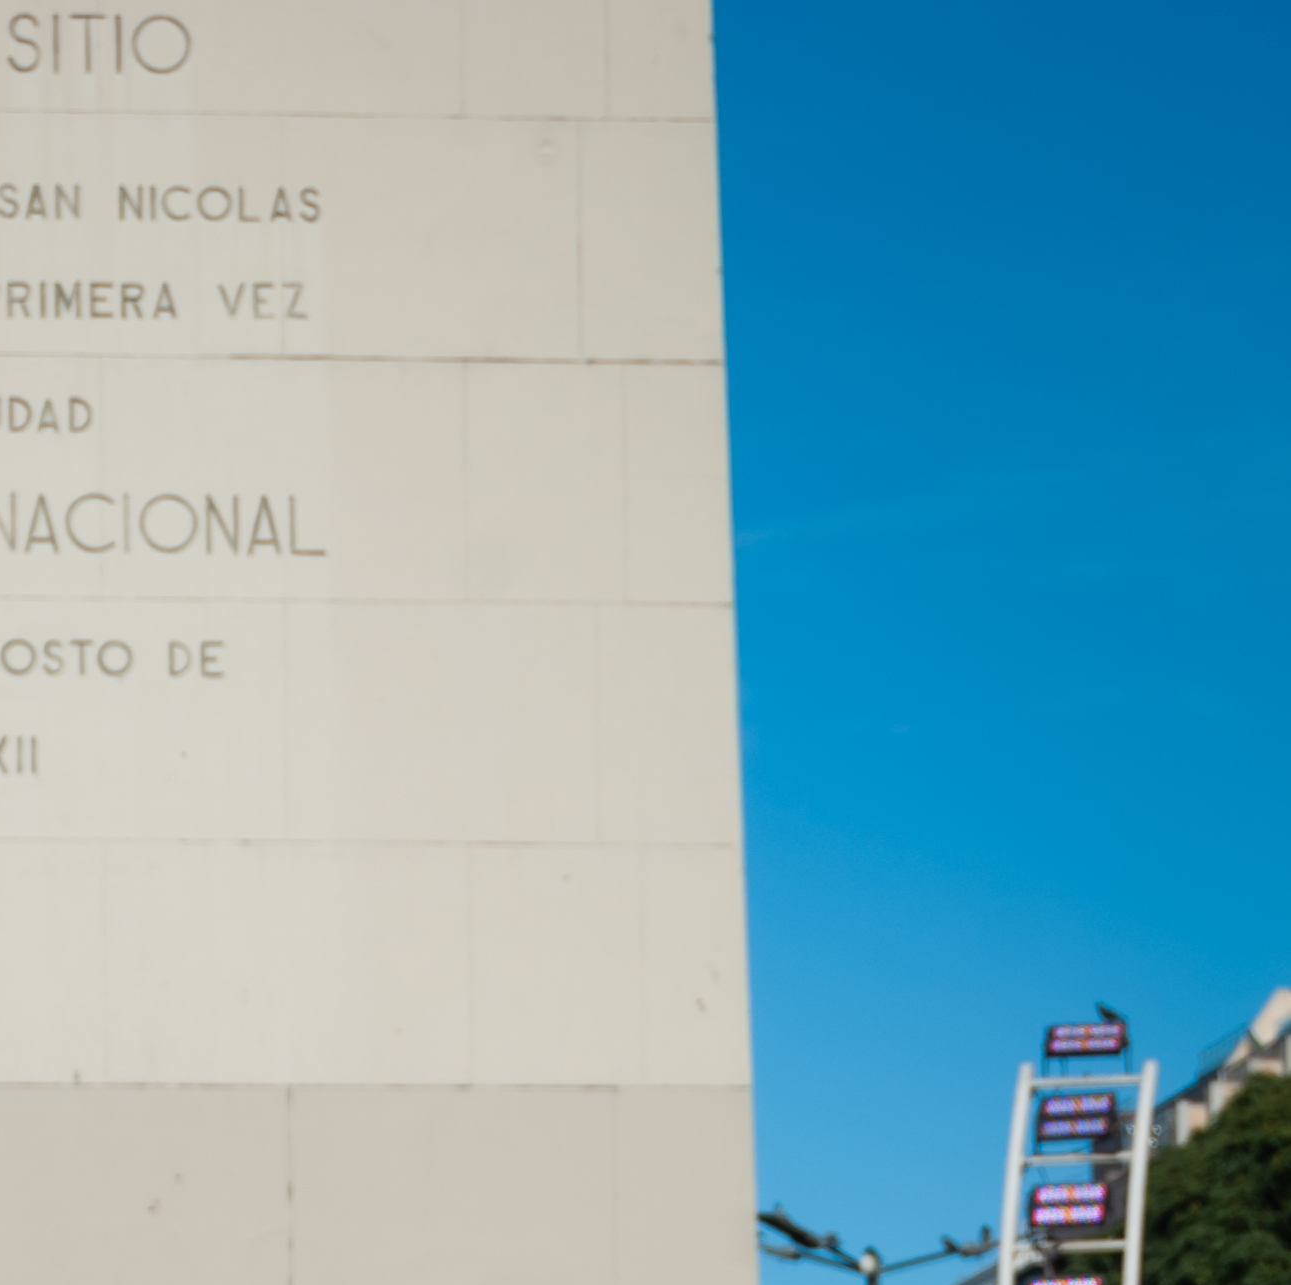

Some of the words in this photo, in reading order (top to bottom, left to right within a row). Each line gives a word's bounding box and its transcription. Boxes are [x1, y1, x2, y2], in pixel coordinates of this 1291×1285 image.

[7, 13, 191, 74] SITIO
[118, 185, 320, 223] NICOLAS
[218, 282, 307, 319] VEZ
[168, 641, 223, 679] DE
